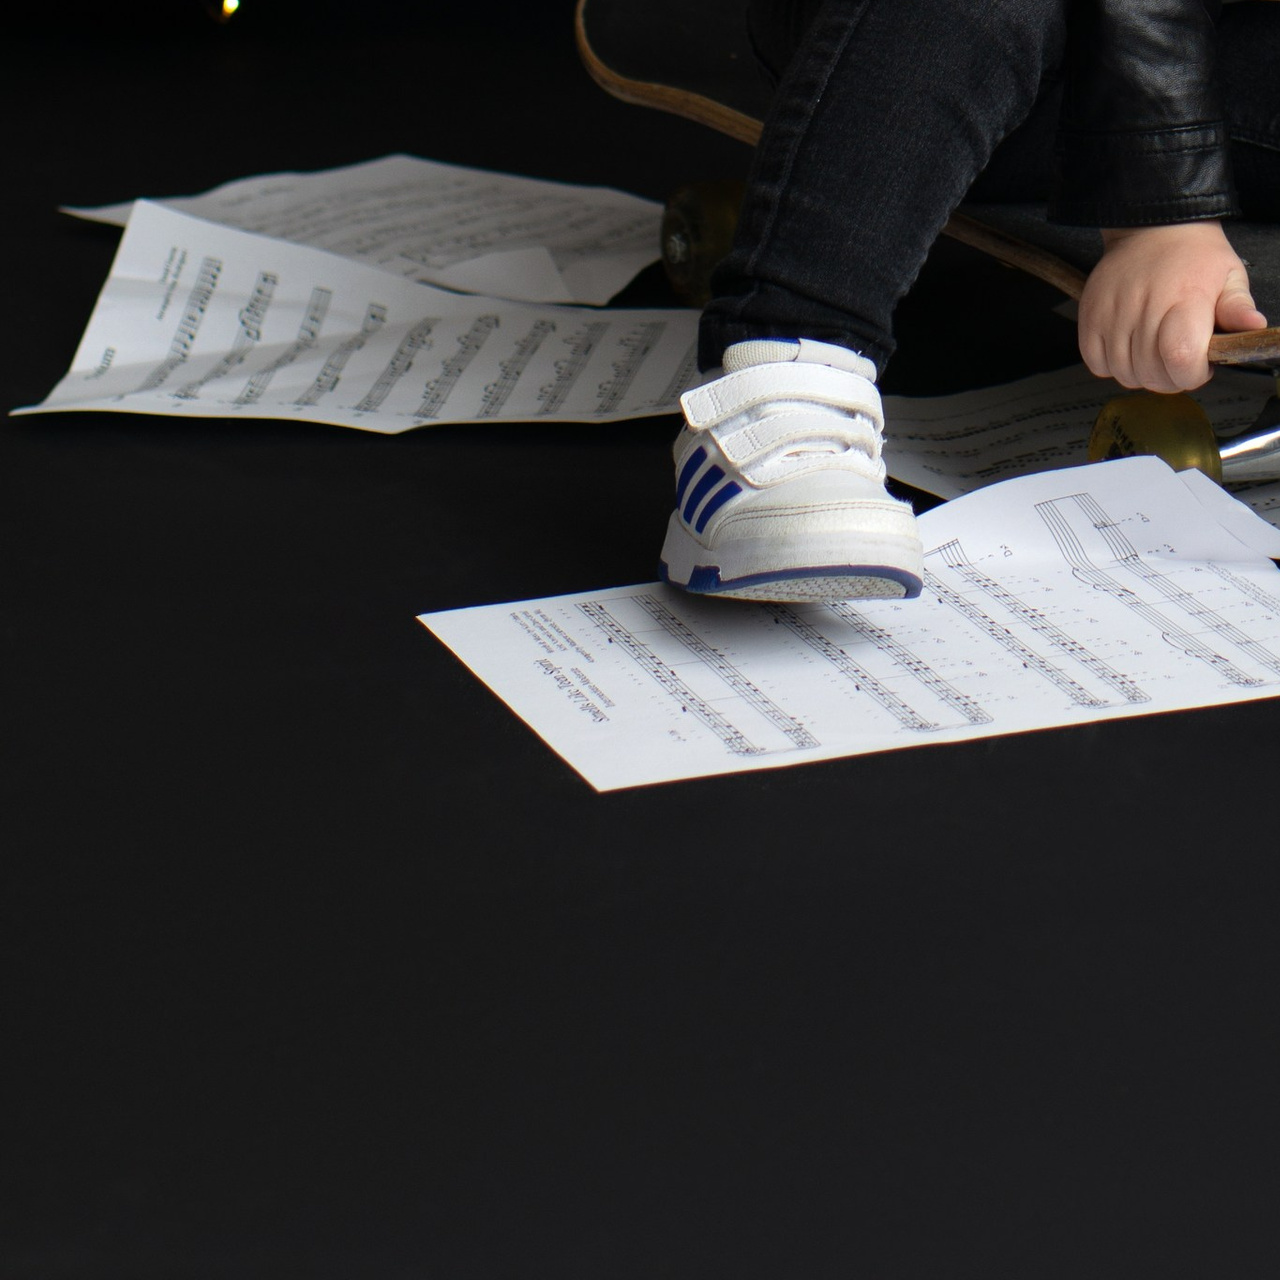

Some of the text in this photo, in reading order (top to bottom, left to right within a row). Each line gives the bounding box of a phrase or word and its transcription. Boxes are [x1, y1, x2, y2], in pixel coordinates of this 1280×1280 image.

[533, 658, 563, 675] Spirit
[554, 674, 574, 690] Teen
[568, 689, 590, 703] Like
[579, 702, 610, 722] Smells
